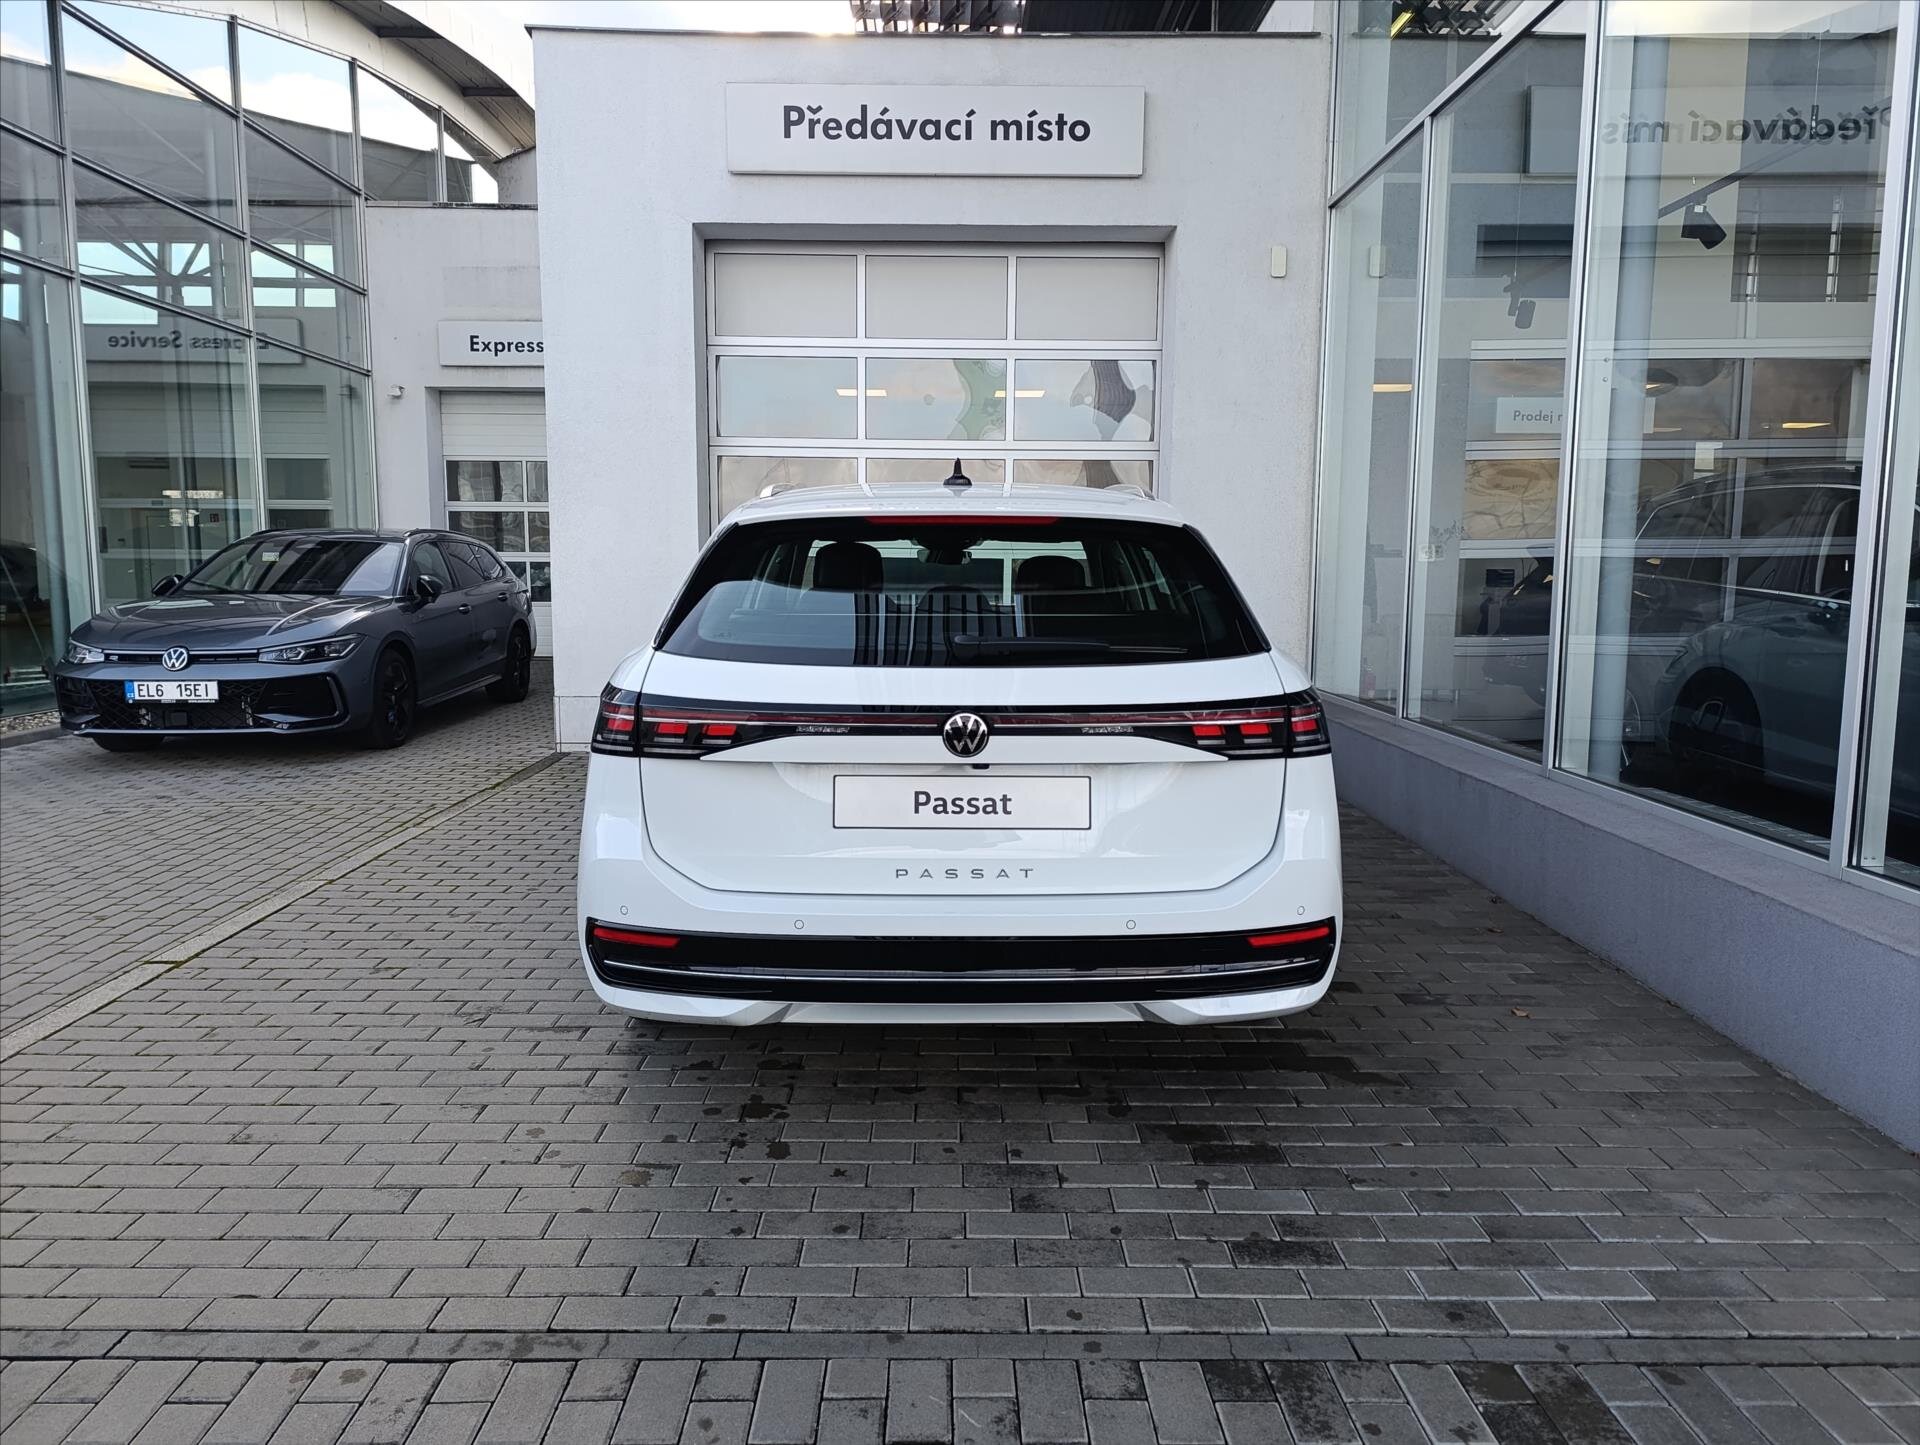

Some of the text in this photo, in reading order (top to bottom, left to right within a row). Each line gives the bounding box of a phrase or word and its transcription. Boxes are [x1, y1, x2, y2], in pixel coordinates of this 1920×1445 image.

[783, 104, 1091, 142] Předávací místo
[469, 334, 544, 357] Express
[1513, 410, 1553, 424] Prodej
[137, 683, 209, 698] EL6 15EI
[913, 790, 1013, 815] Passat
[895, 868, 1034, 879] PASSAT
